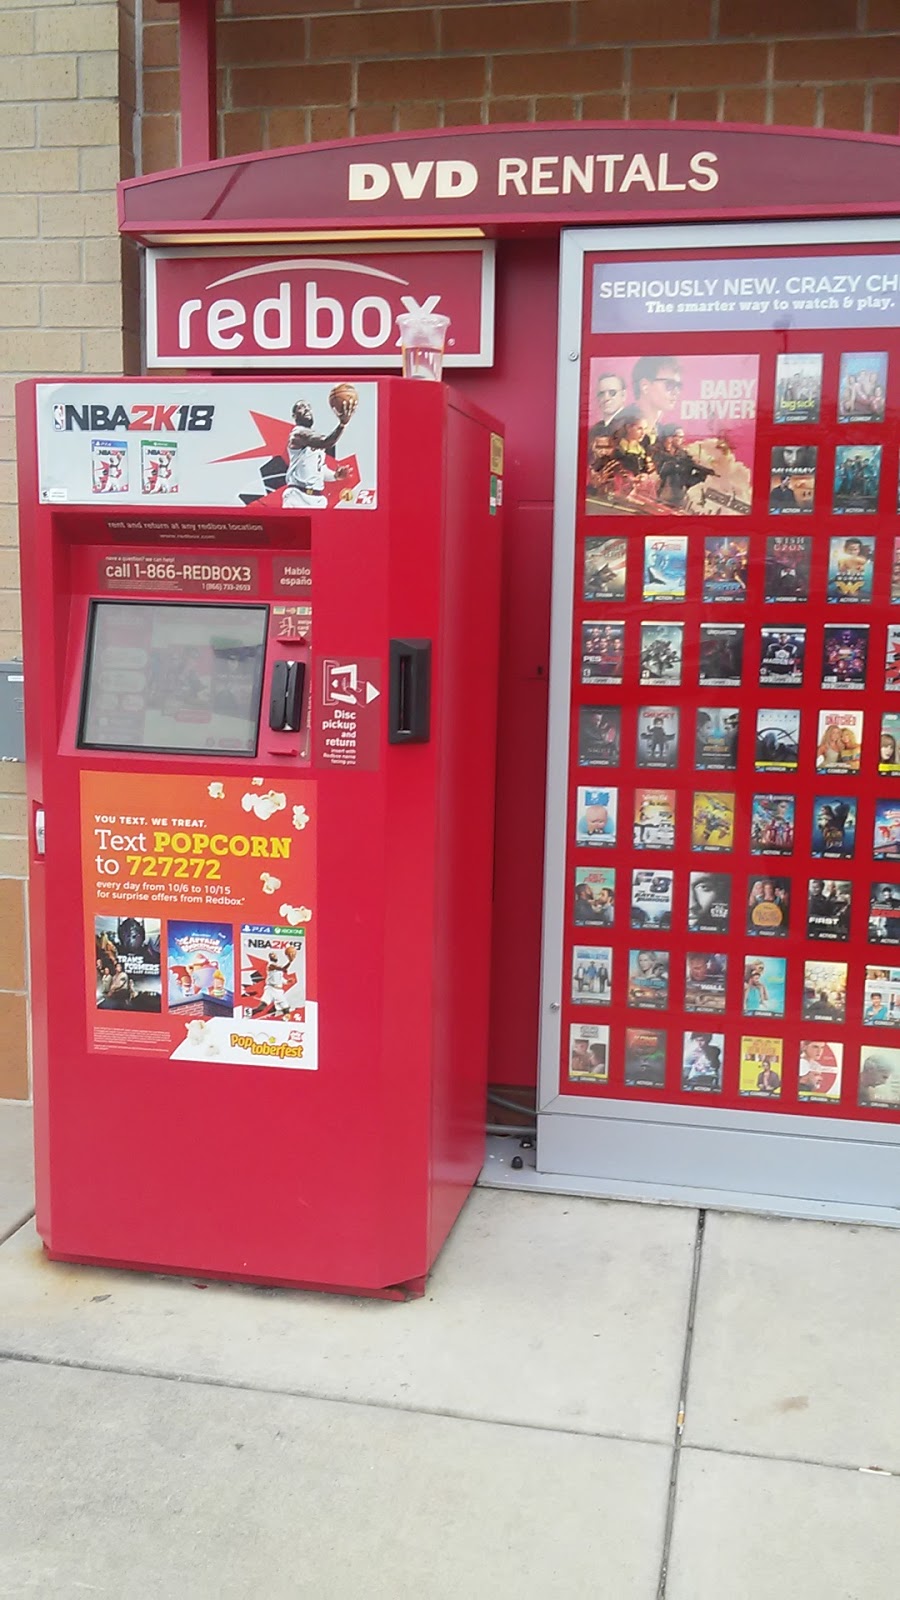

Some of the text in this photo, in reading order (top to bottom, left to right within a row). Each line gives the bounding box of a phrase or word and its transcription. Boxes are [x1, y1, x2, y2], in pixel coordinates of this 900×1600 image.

[348, 151, 719, 201] DVD RENTALS
[600, 273, 900, 298] SERIOUSLY NEW. CRAZY CH
[645, 295, 895, 313] The smarter way to watch & play.
[178, 281, 441, 351] redbox
[700, 378, 756, 400] BABY
[65, 404, 215, 431] NBA2K18
[680, 400, 756, 421] DRIVER
[108, 521, 125, 529] rent
[144, 522, 169, 530] return
[171, 522, 180, 530] at
[181, 524, 196, 532] any
[198, 523, 227, 531] redbox
[228, 523, 263, 531] location
[105, 563, 251, 582] call 1-866-REDBOX3
[284, 566, 311, 576] Hablo
[280, 575, 312, 587] españo
[334, 709, 356, 719] Disc
[322, 719, 356, 731] pickup
[341, 731, 356, 739] and
[325, 738, 356, 747] return
[94, 815, 207, 828] YOU TEXT. WE TREAT.
[94, 829, 292, 858] Text POPCORN
[95, 855, 221, 880] to 727272
[96, 881, 231, 895] every day from 10/6 to 10/15
[96, 889, 110, 899] for
[112, 891, 149, 902] surprise
[150, 892, 178, 903] offers
[180, 894, 203, 904] from
[808, 916, 840, 925] FIRST
[117, 955, 144, 963] TRANS
[124, 963, 160, 971] FORMERS
